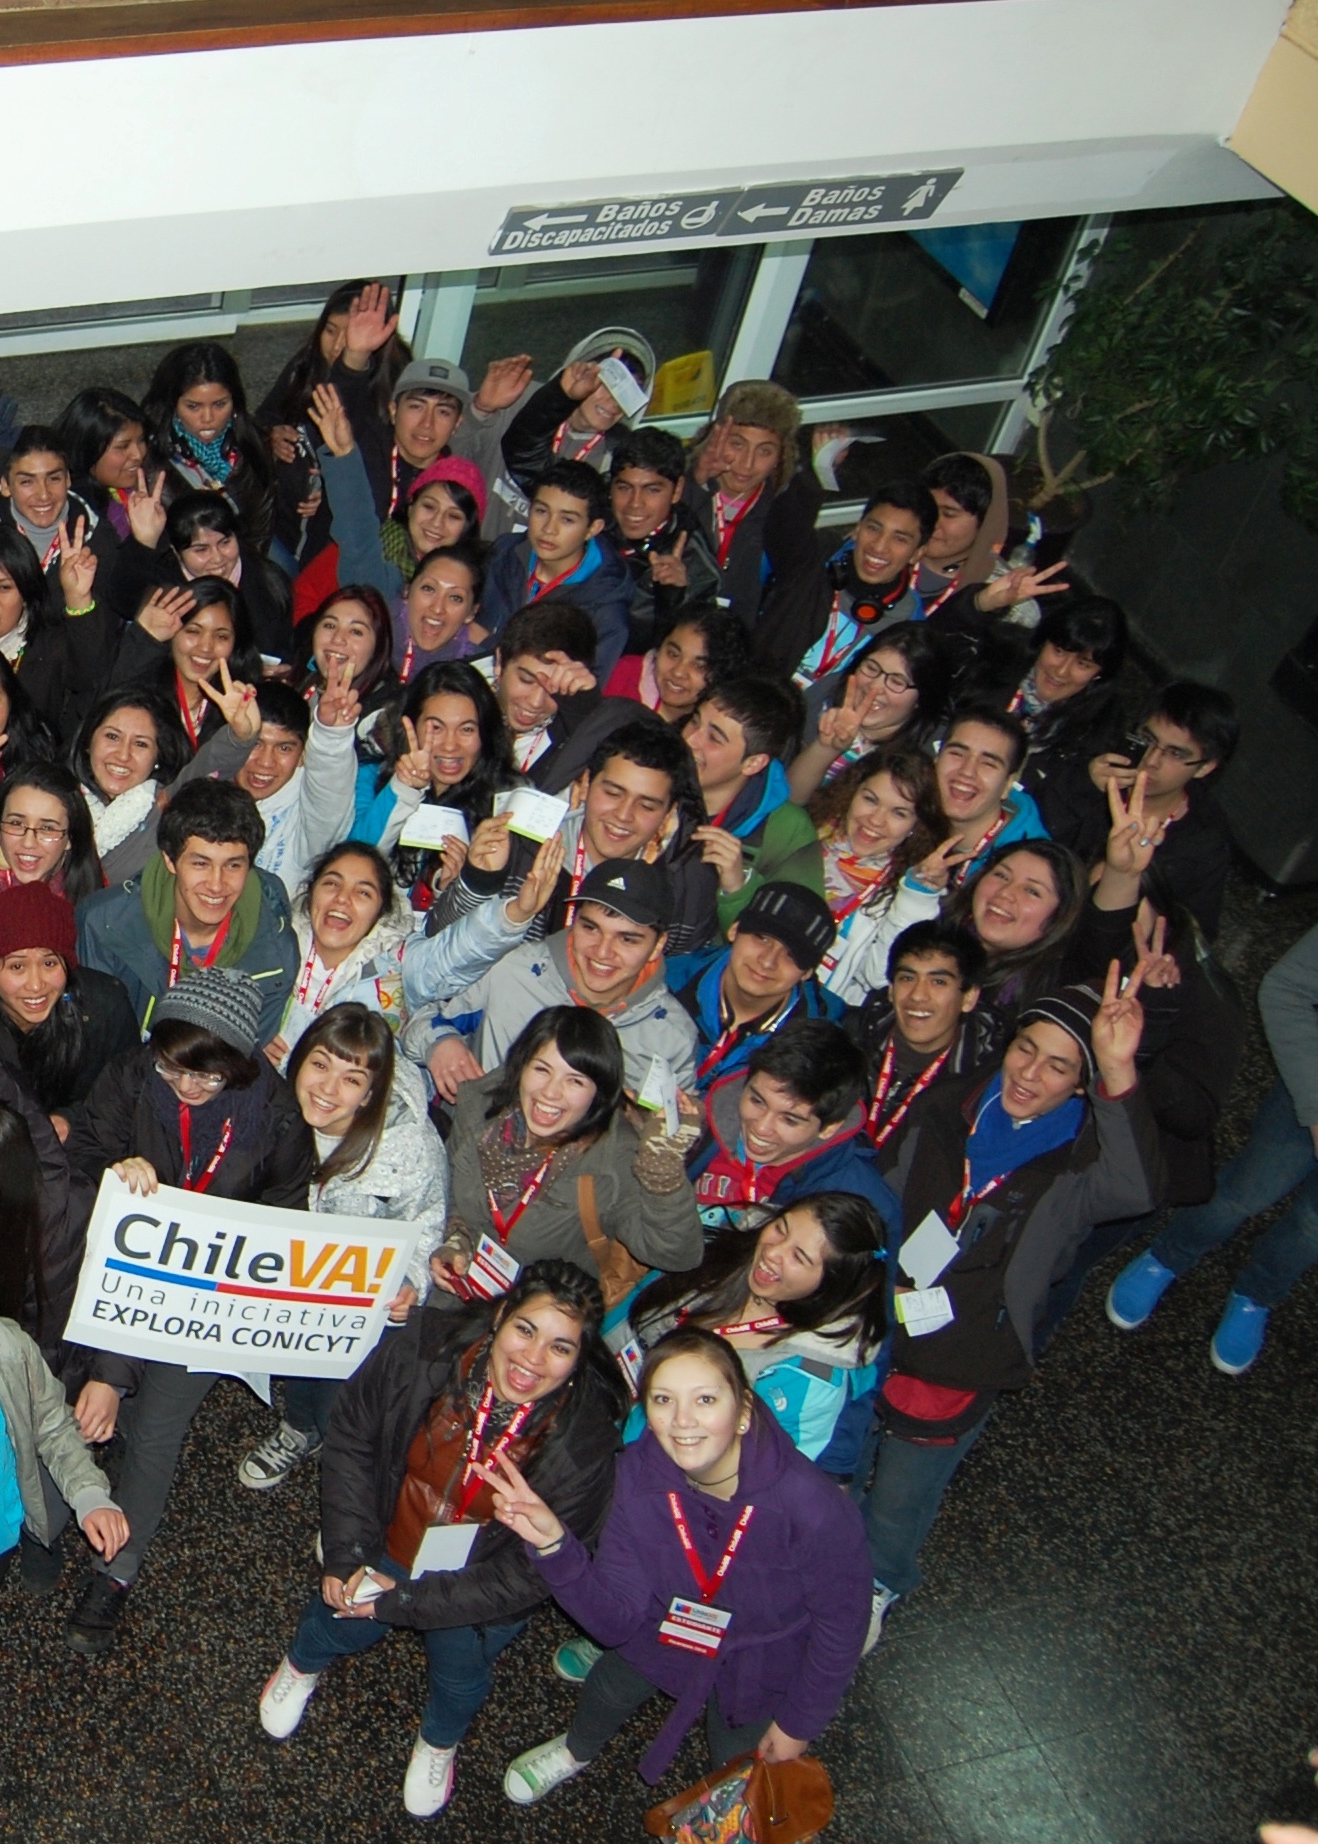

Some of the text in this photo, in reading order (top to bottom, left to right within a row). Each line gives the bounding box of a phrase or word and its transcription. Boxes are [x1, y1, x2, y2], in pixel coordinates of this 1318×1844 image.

[803, 183, 885, 207] Baños
[596, 200, 683, 223] Baños
[787, 203, 883, 227] Damas
[503, 220, 672, 251] Discapacitados
[100, 1272, 367, 1330] Una iniciativa
[92, 1299, 361, 1354] EXPLORA CONICYT
